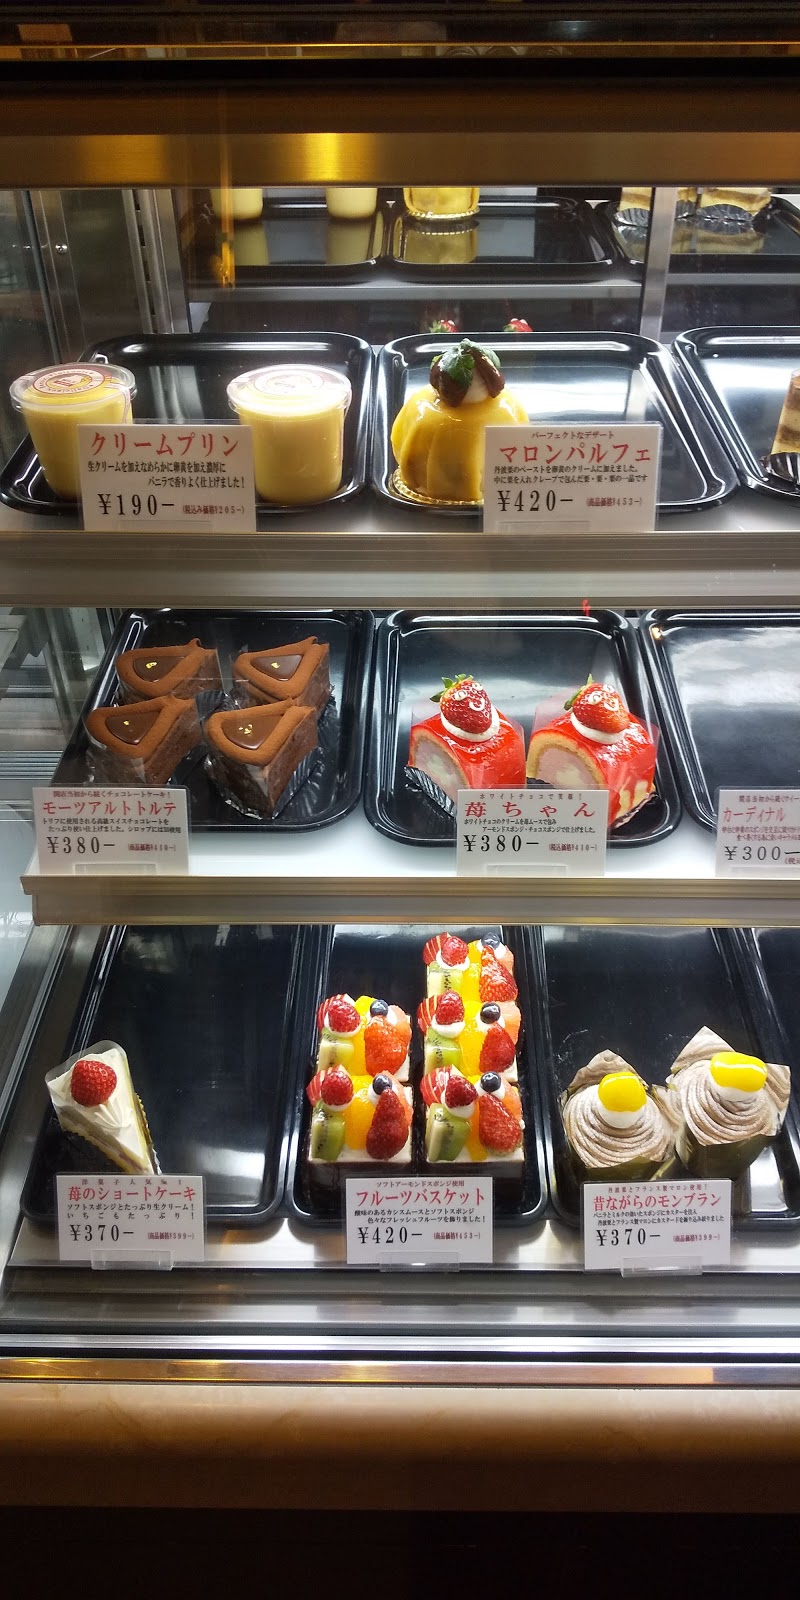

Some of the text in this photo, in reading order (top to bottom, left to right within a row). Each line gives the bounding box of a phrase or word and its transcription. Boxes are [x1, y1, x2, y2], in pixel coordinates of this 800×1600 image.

[90, 432, 239, 456] クリームプリン
[499, 442, 651, 464] マロンパルフェ
[98, 493, 174, 515] ¥190-
[498, 490, 573, 511] ¥420-
[43, 800, 176, 815] モーツアルトトルテ
[464, 802, 595, 817] 苺ちゃん
[723, 806, 785, 822] カーディナル
[47, 836, 115, 853] ¥380-
[464, 835, 539, 852] ¥380-
[68, 1186, 196, 1201] 苺のショートケーキ
[356, 1188, 485, 1207] フルーツバスケット
[593, 1193, 721, 1211] 昔ながらのモンブラン
[70, 1225, 134, 1241] ¥370-
[358, 1227, 422, 1244] ¥420-
[596, 1228, 661, 1246] ¥370-
